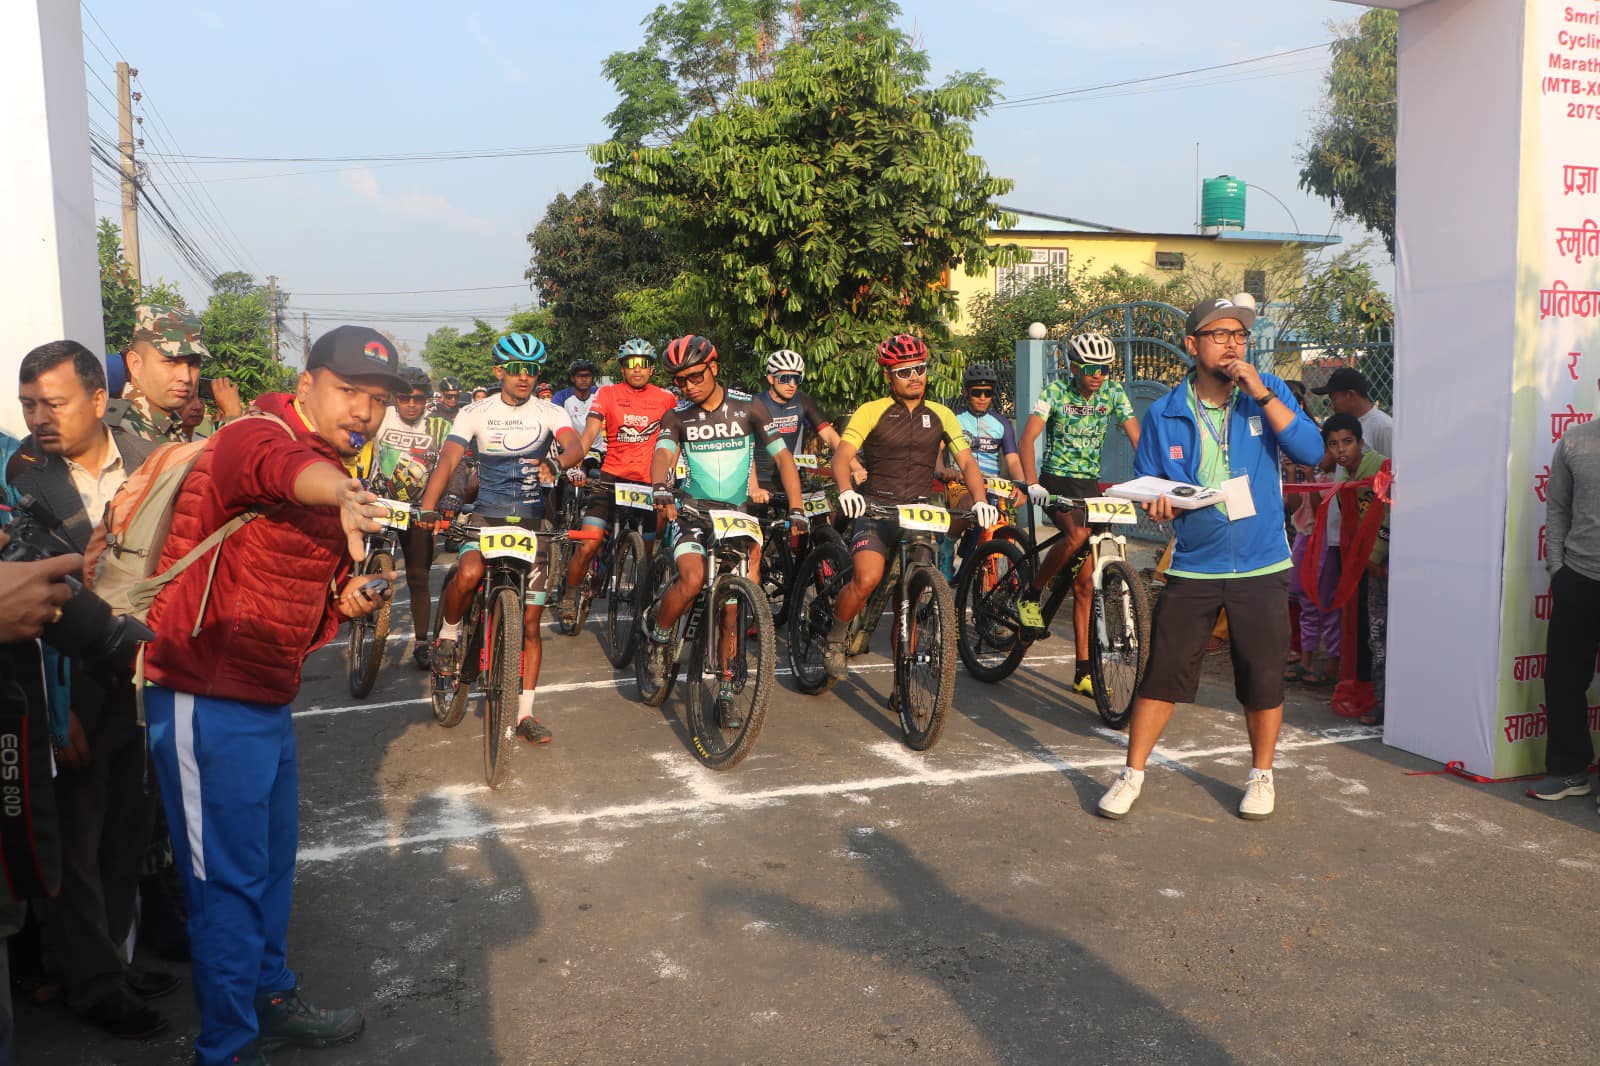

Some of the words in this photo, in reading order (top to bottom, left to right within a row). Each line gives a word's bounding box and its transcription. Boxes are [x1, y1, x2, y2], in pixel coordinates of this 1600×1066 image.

[1563, 164, 1599, 196] प्रज्ञा
[1556, 218, 1600, 264] स्मृति
[1539, 279, 1600, 321] प्रतिष्ठा
[1567, 352, 1582, 381] र
[686, 421, 745, 441] BORA
[691, 439, 743, 451] hansgrohe
[903, 508, 946, 523] 101
[1088, 502, 1132, 514] 102
[484, 534, 534, 551] 104
[1, 733, 19, 780] EOS
[3, 786, 22, 816] 80D
